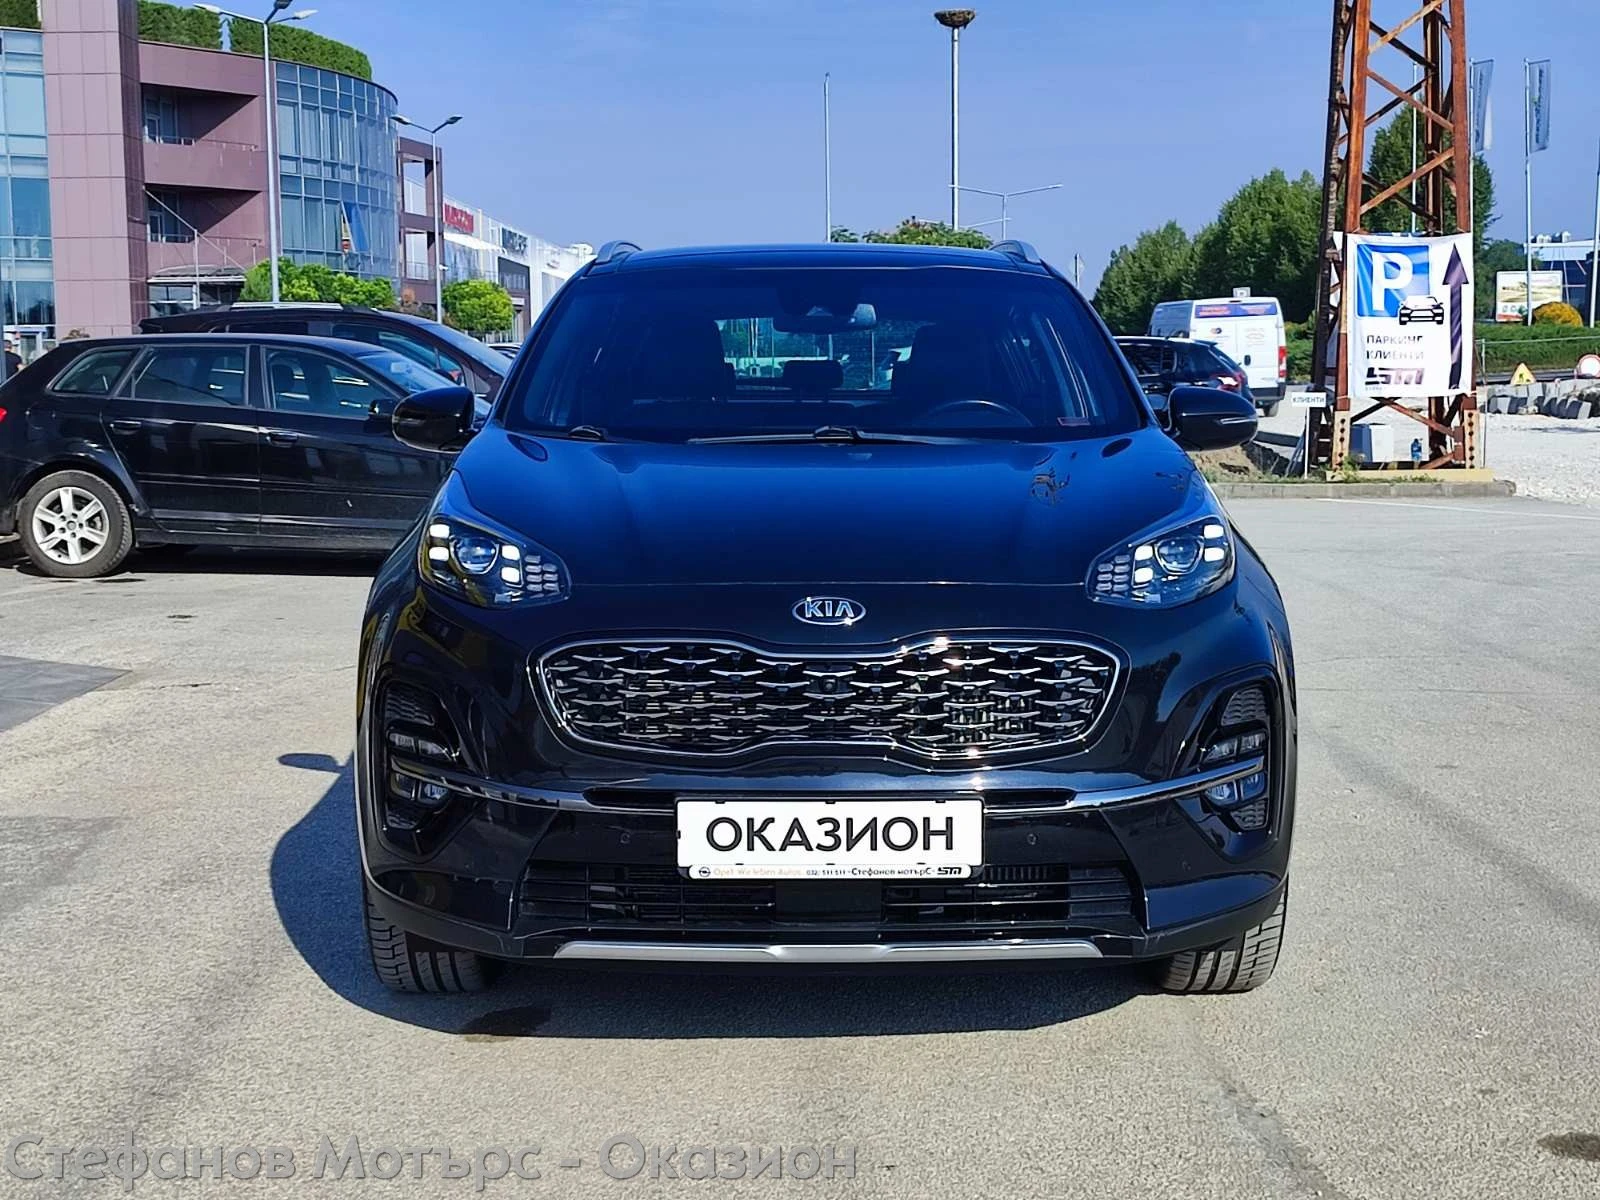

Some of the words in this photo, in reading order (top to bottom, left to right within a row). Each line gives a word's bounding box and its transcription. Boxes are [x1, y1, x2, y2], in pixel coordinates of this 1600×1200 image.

[1366, 334, 1424, 345] ПАРКИНГ
[1366, 350, 1424, 360] КЛИЕНТИ
[804, 600, 855, 618] KIA
[706, 817, 953, 852] ОКАЗИОН
